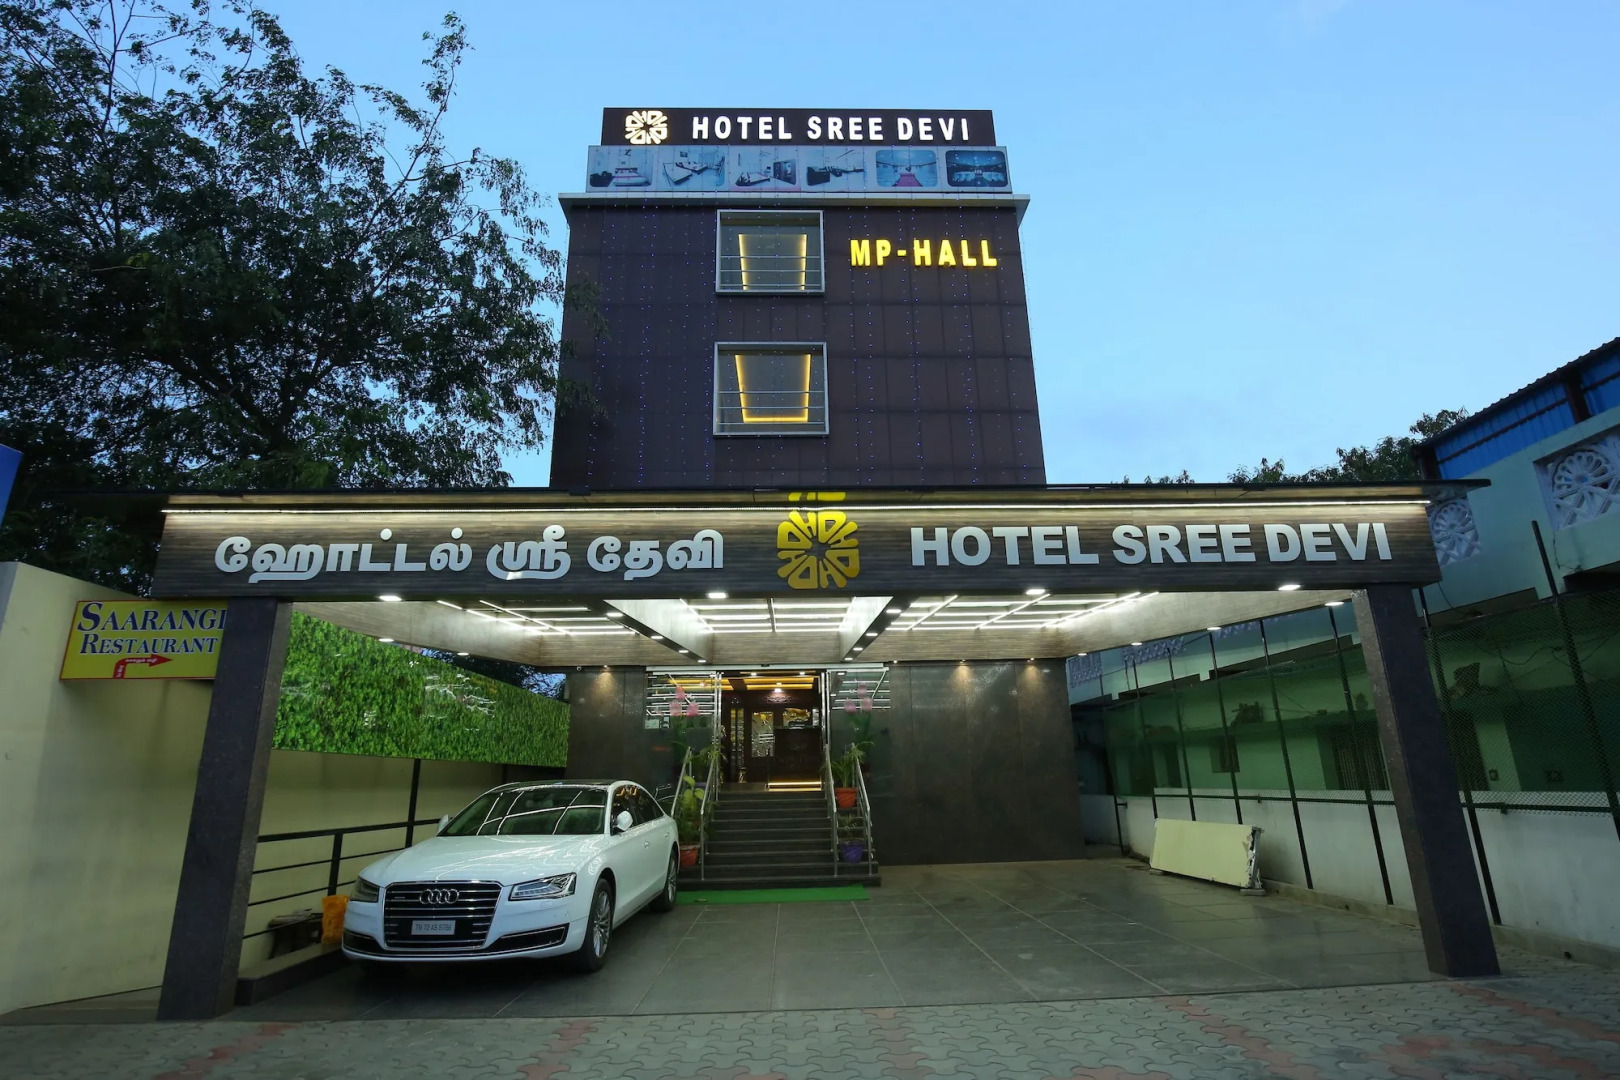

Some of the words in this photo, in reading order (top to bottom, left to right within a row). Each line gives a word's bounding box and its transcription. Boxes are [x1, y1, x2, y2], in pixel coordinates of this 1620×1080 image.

[692, 116, 792, 140] HOTEL
[807, 116, 884, 141] SREE
[897, 117, 970, 141] DEVI
[850, 239, 998, 267] MP-HALL
[215, 528, 473, 583] ஹோட்டல்
[587, 529, 724, 580] தேவி
[911, 526, 1099, 566] HOTEL
[1112, 524, 1256, 564] SREE
[1264, 523, 1391, 562] DEVI
[77, 602, 227, 632] SAARANGI
[80, 633, 218, 655] RESTAURANT
